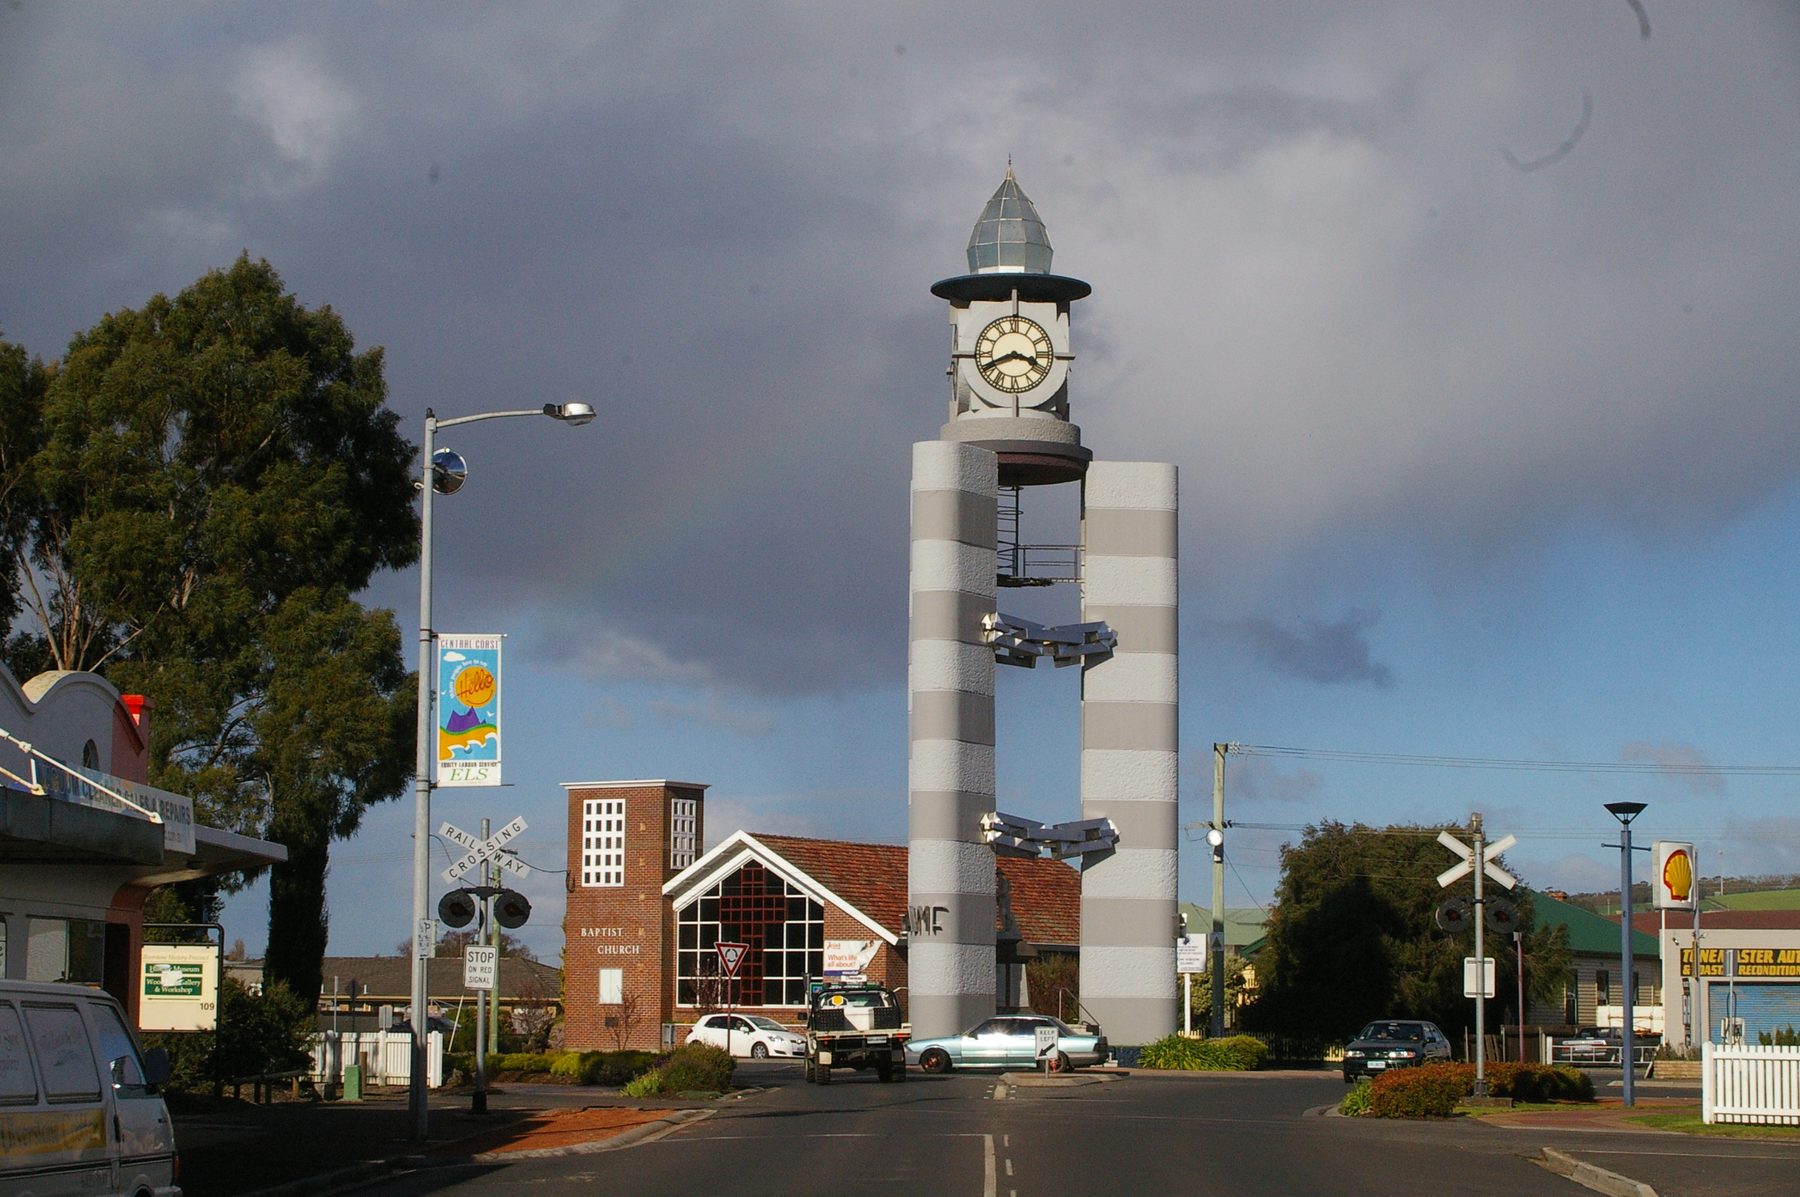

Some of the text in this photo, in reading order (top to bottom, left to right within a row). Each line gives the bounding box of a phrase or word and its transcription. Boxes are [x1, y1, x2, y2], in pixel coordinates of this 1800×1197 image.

[441, 640, 498, 649] CENTRAL COAST
[456, 668, 494, 698] Hello
[450, 768, 488, 781] ELS
[160, 799, 191, 826] REPAIRS
[448, 822, 521, 878] CROSSING
[581, 927, 624, 937] BAPTIST
[597, 945, 640, 954] CHURCH
[468, 951, 494, 963] STOP
[480, 966, 492, 974] RED
[468, 976, 490, 984] SIGNAL
[161, 986, 193, 994] Workshop
[199, 1002, 215, 1011] 109
